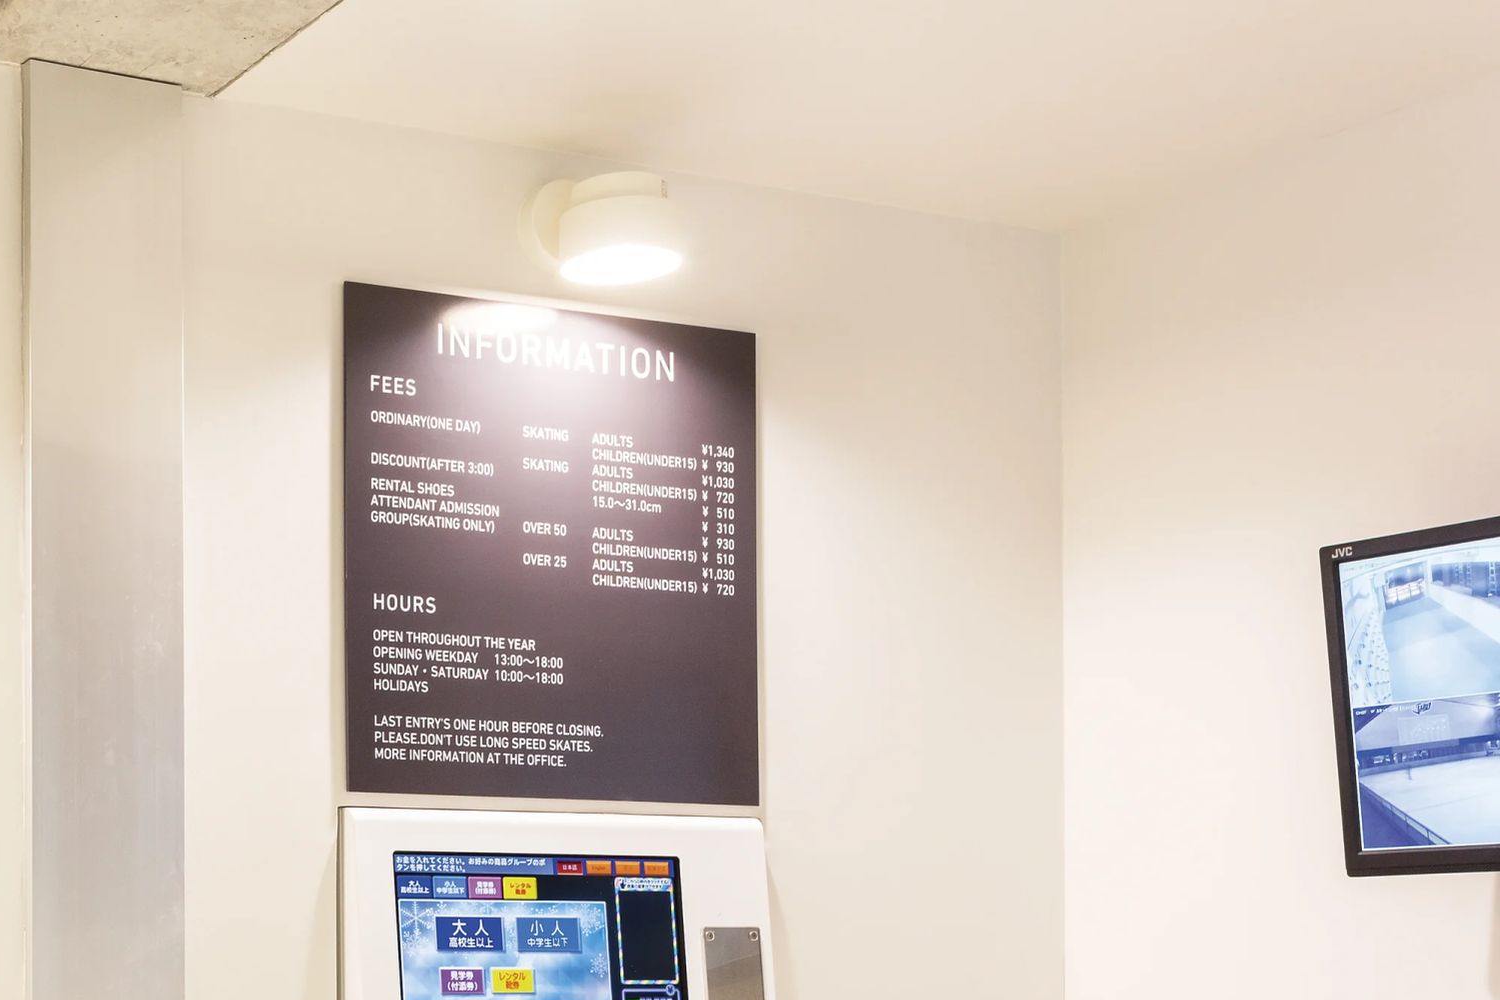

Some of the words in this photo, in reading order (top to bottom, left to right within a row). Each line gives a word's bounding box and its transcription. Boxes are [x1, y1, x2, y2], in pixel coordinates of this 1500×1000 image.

[438, 320, 674, 382] INFORMATION
[371, 375, 416, 395] FEES
[371, 411, 452, 430] ORDINARY(ONE
[456, 419, 480, 434] DAY)
[523, 426, 569, 441] SKATING
[592, 433, 633, 448] ADULTS
[702, 445, 734, 458] ¥1,340
[371, 452, 464, 472] DISCOUNT(AFTER
[468, 462, 494, 476] 3:00)
[523, 458, 569, 473] SKATING
[592, 465, 633, 479] ADULTS
[702, 475, 734, 489] ¥1,030
[593, 449, 697, 470] CHILDREN(UNDER15)
[716, 461, 734, 473] 930
[371, 478, 414, 492] RENTAL
[418, 482, 454, 496] SHOES
[717, 508, 734, 519] 510
[593, 480, 697, 501] CHILDREN(UNDER15)
[717, 492, 734, 504] 720
[371, 495, 436, 510] ATTENDANT
[439, 501, 499, 517] ADMISSION
[717, 523, 734, 535] 310
[371, 511, 464, 529] GROUP(SKATING
[463, 519, 494, 533] ONLY)
[523, 521, 551, 534] OVER
[554, 524, 566, 536] 50
[592, 528, 633, 541] ADULTS
[717, 538, 734, 550] 930
[593, 543, 697, 562] CHILDREN(UNDER15)
[717, 553, 734, 565] 510
[1331, 546, 1353, 559] JVC
[523, 553, 551, 566] OVER
[554, 556, 566, 568] 25
[593, 559, 633, 572] ADULTS
[703, 568, 734, 580] ¥1,030
[593, 574, 697, 593] CHILDREN(UNDER15)
[717, 584, 734, 596] 720
[374, 593, 436, 613] HOURS
[373, 629, 403, 642] OPEN
[406, 632, 481, 647] THROUGHOUT
[484, 637, 505, 649] THE
[508, 639, 535, 650] YEAR
[373, 646, 422, 660] OPENING
[425, 650, 478, 663] WEEKDAY
[374, 663, 418, 675] SUNDAY
[431, 666, 488, 680] SATURDAY
[374, 679, 428, 692] HOLIDAYS
[375, 715, 402, 727] LAST
[406, 716, 450, 729] ENTRY'S
[454, 719, 475, 730] ONE
[479, 720, 508, 732] HOUR
[512, 722, 553, 734] BEFORE
[556, 724, 603, 737] CLOSING.
[456, 735, 476, 746] USE
[480, 736, 508, 748] LONG
[512, 738, 546, 750] SPEED
[550, 740, 592, 752] SKATES.
[375, 748, 406, 760] MORE
[410, 750, 483, 763] INFORMATION
[487, 753, 500, 763] AT
[503, 753, 524, 765] THE
[527, 755, 566, 766] OFFICE.
[451, 919, 489, 936] 大人
[530, 920, 565, 936] 小人
[449, 937, 494, 948] 高校生以上
[527, 938, 568, 948] 中学生以下
